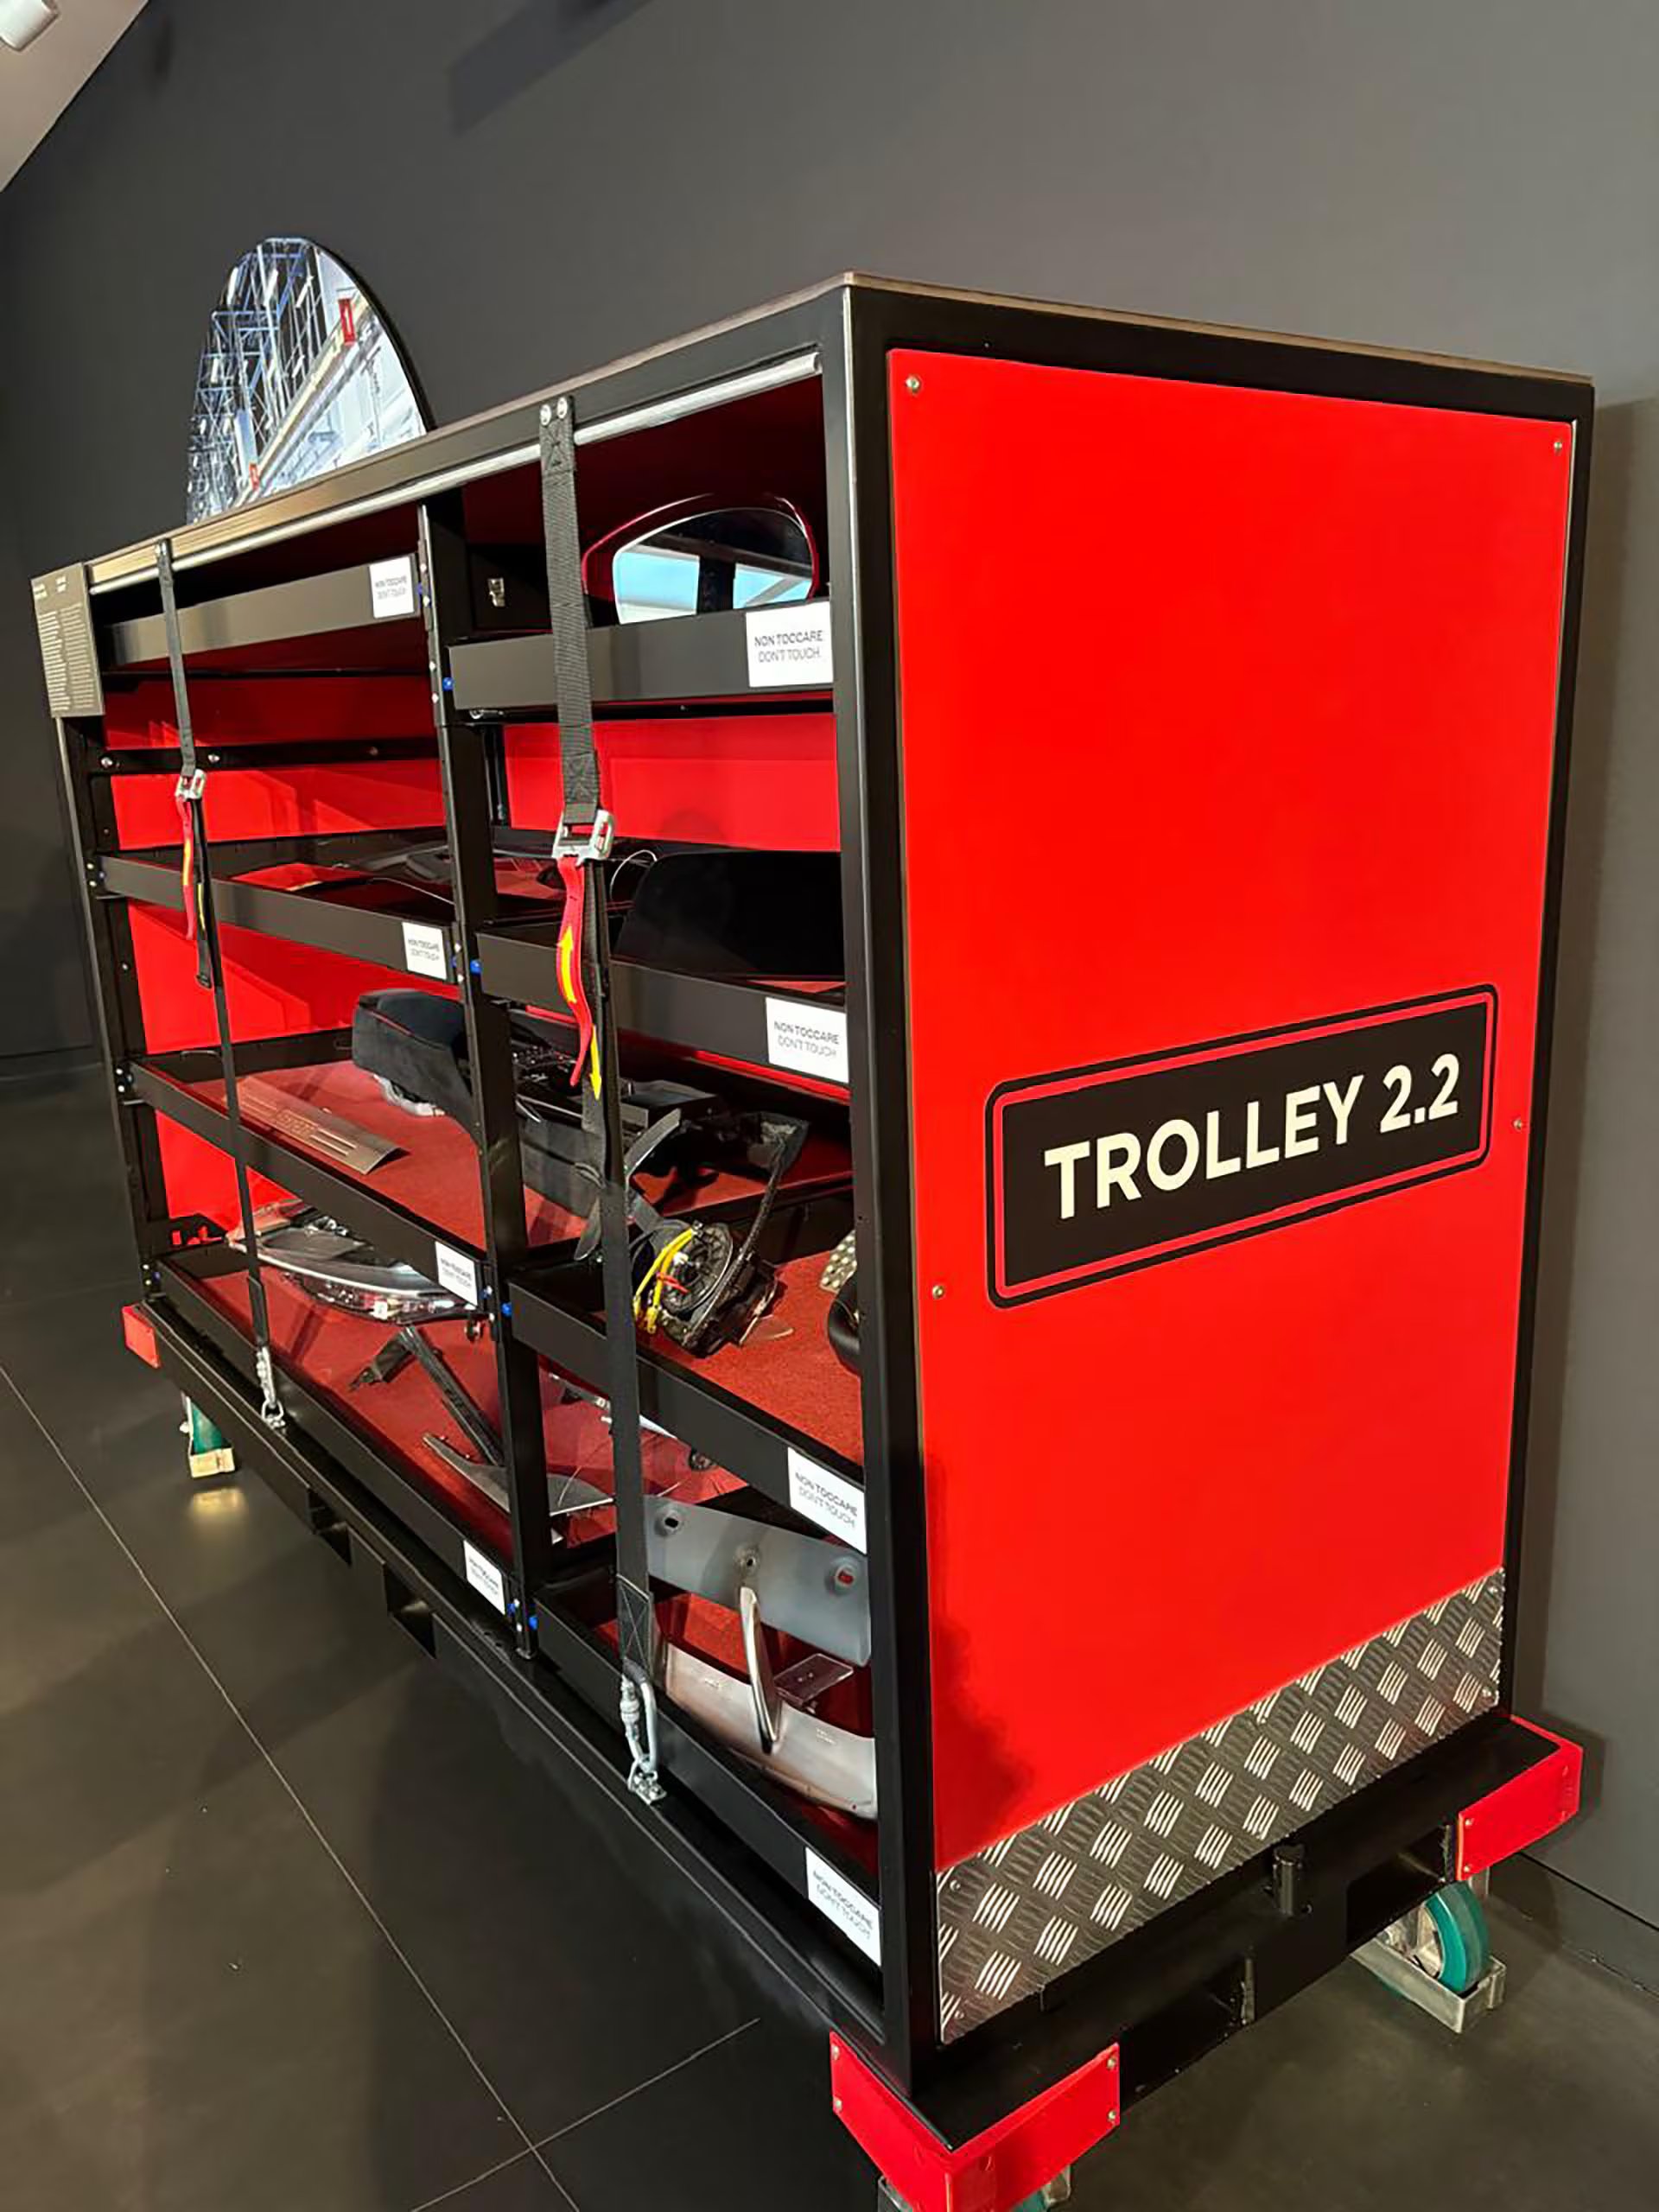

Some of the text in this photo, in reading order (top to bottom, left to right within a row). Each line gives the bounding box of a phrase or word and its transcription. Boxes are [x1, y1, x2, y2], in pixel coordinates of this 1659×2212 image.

[754, 630, 823, 647] NON TOCCARE
[786, 646, 820, 662] TOUCH
[773, 1020, 839, 1046] NON TOCCARE
[1044, 1052, 1460, 1219] TROLLEY 2.2
